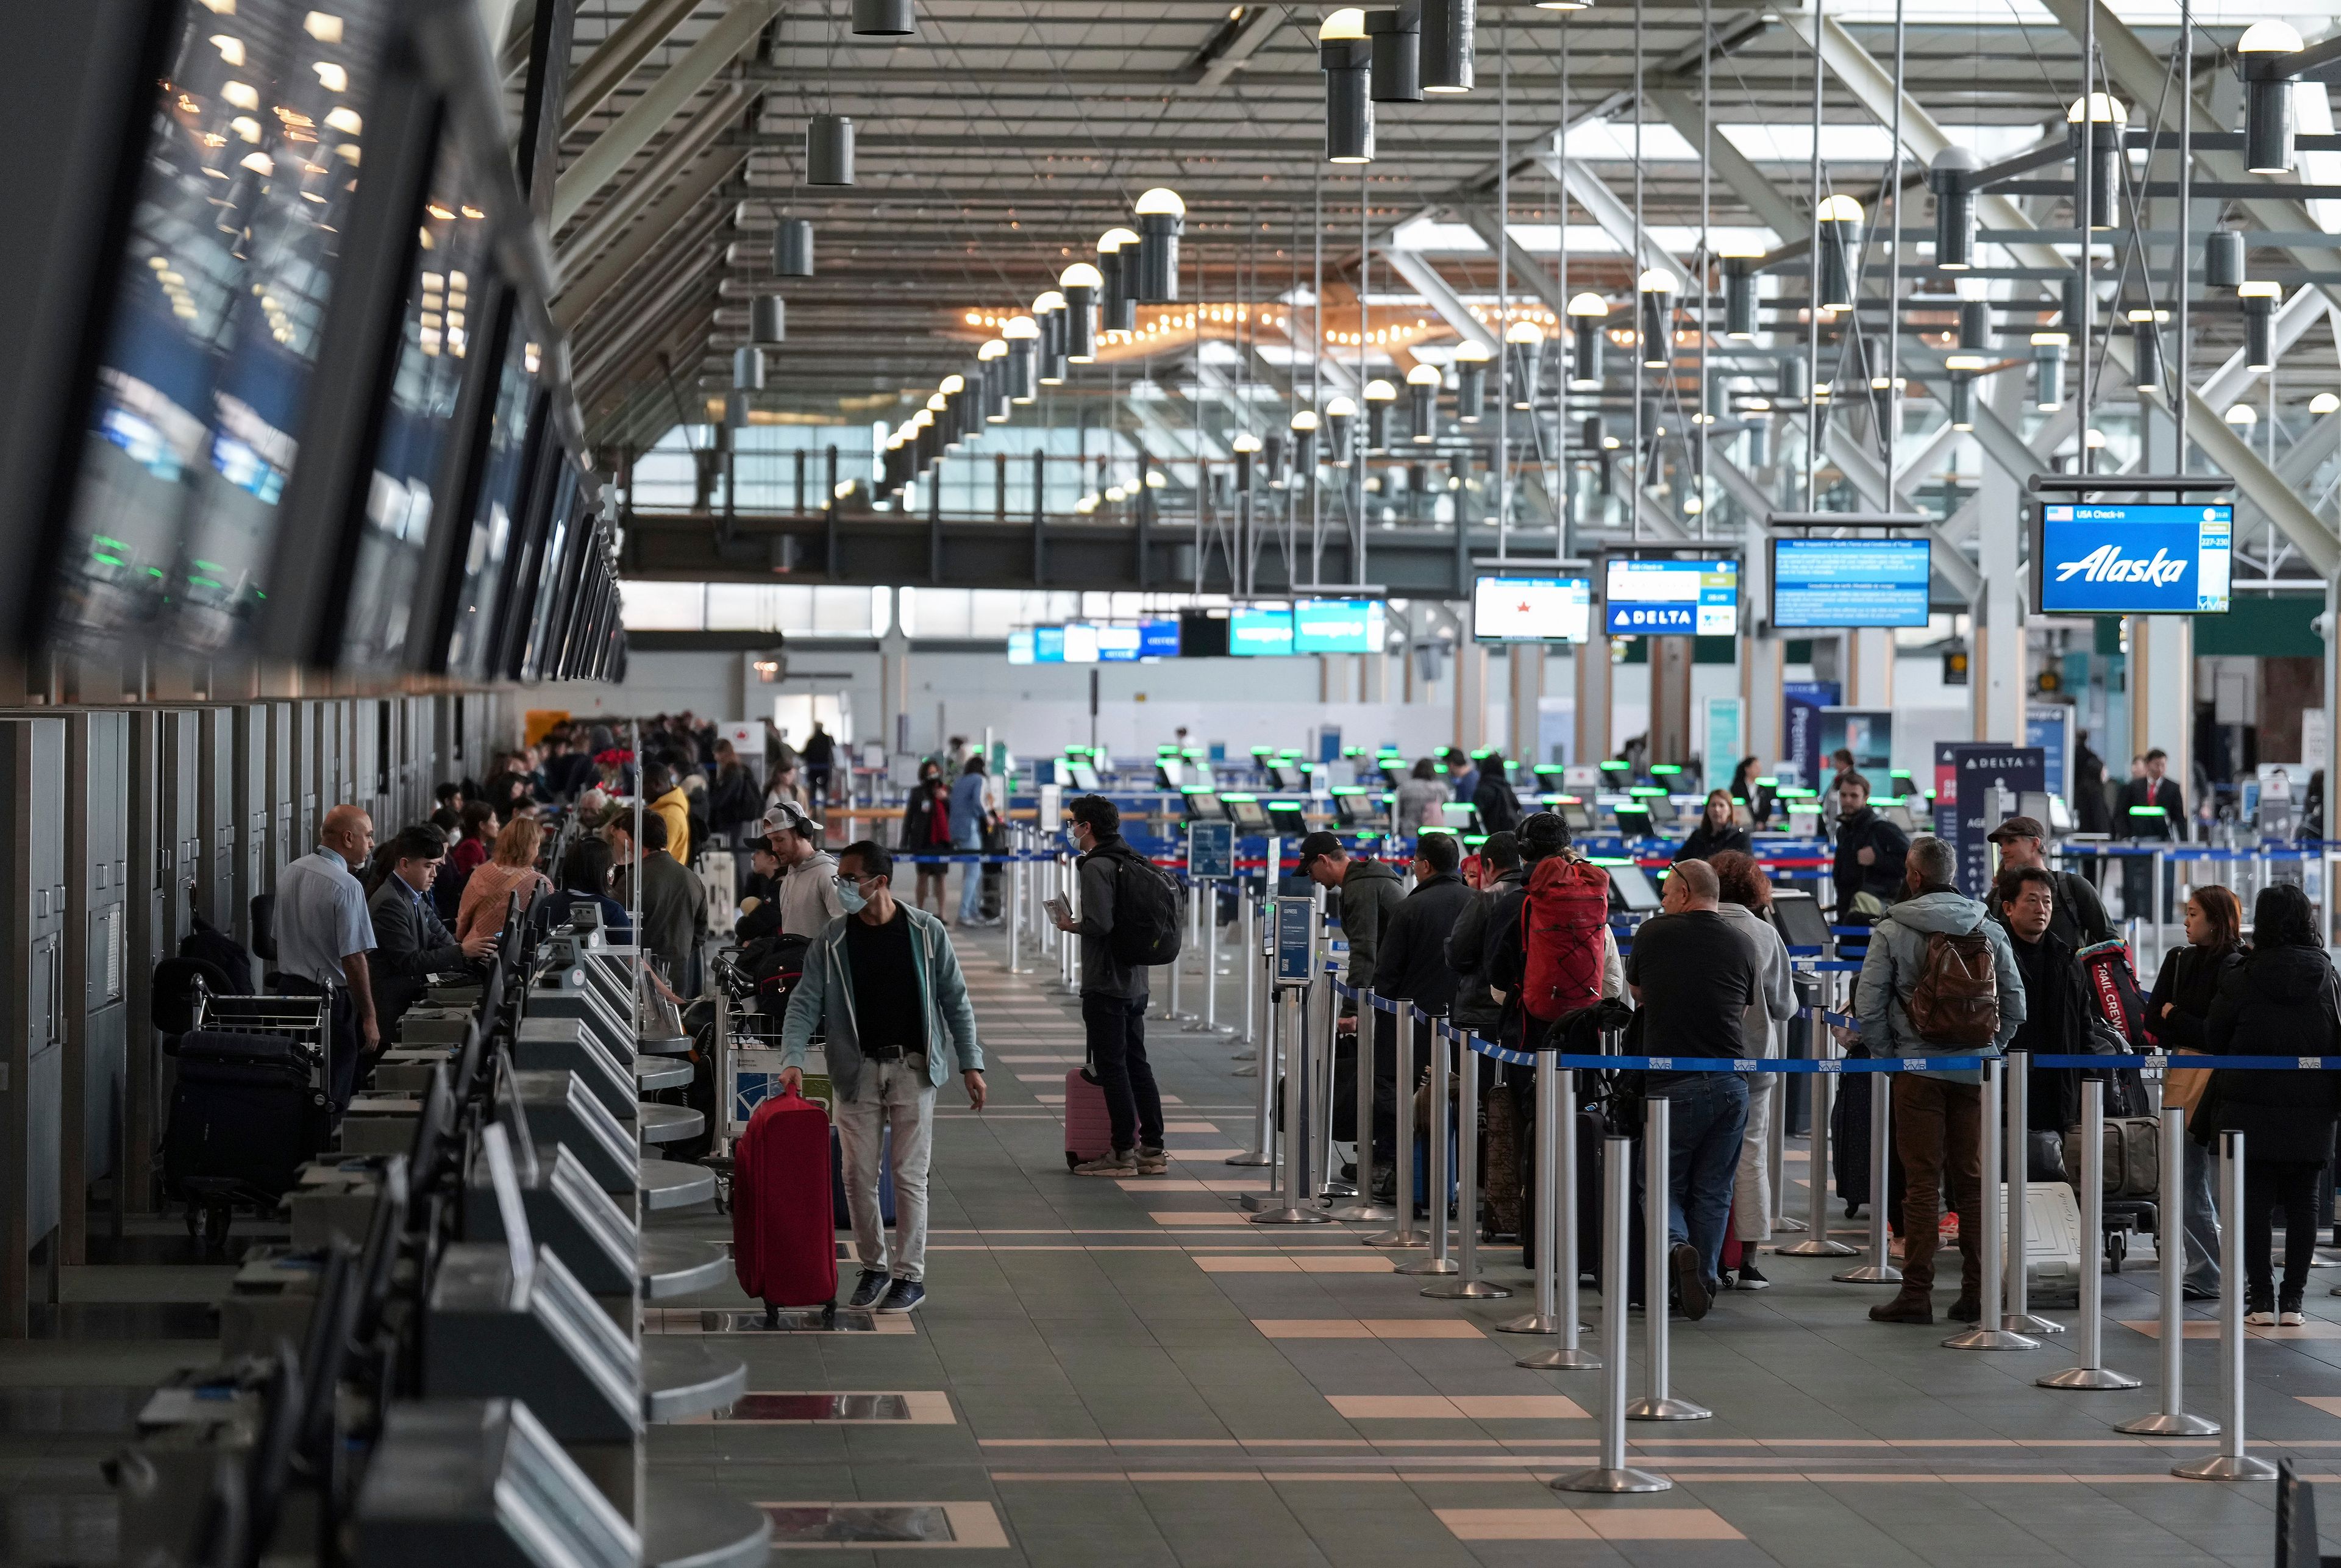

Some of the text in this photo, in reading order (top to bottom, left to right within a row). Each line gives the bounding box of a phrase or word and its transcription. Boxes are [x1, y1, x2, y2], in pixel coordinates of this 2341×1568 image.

[2076, 510, 2125, 519] USA Check-in
[2055, 544, 2188, 588] Alaska
[1633, 610, 1691, 625] DELTA
[1979, 757, 2023, 768] DELTA
[2106, 994, 2124, 1029] CREW
